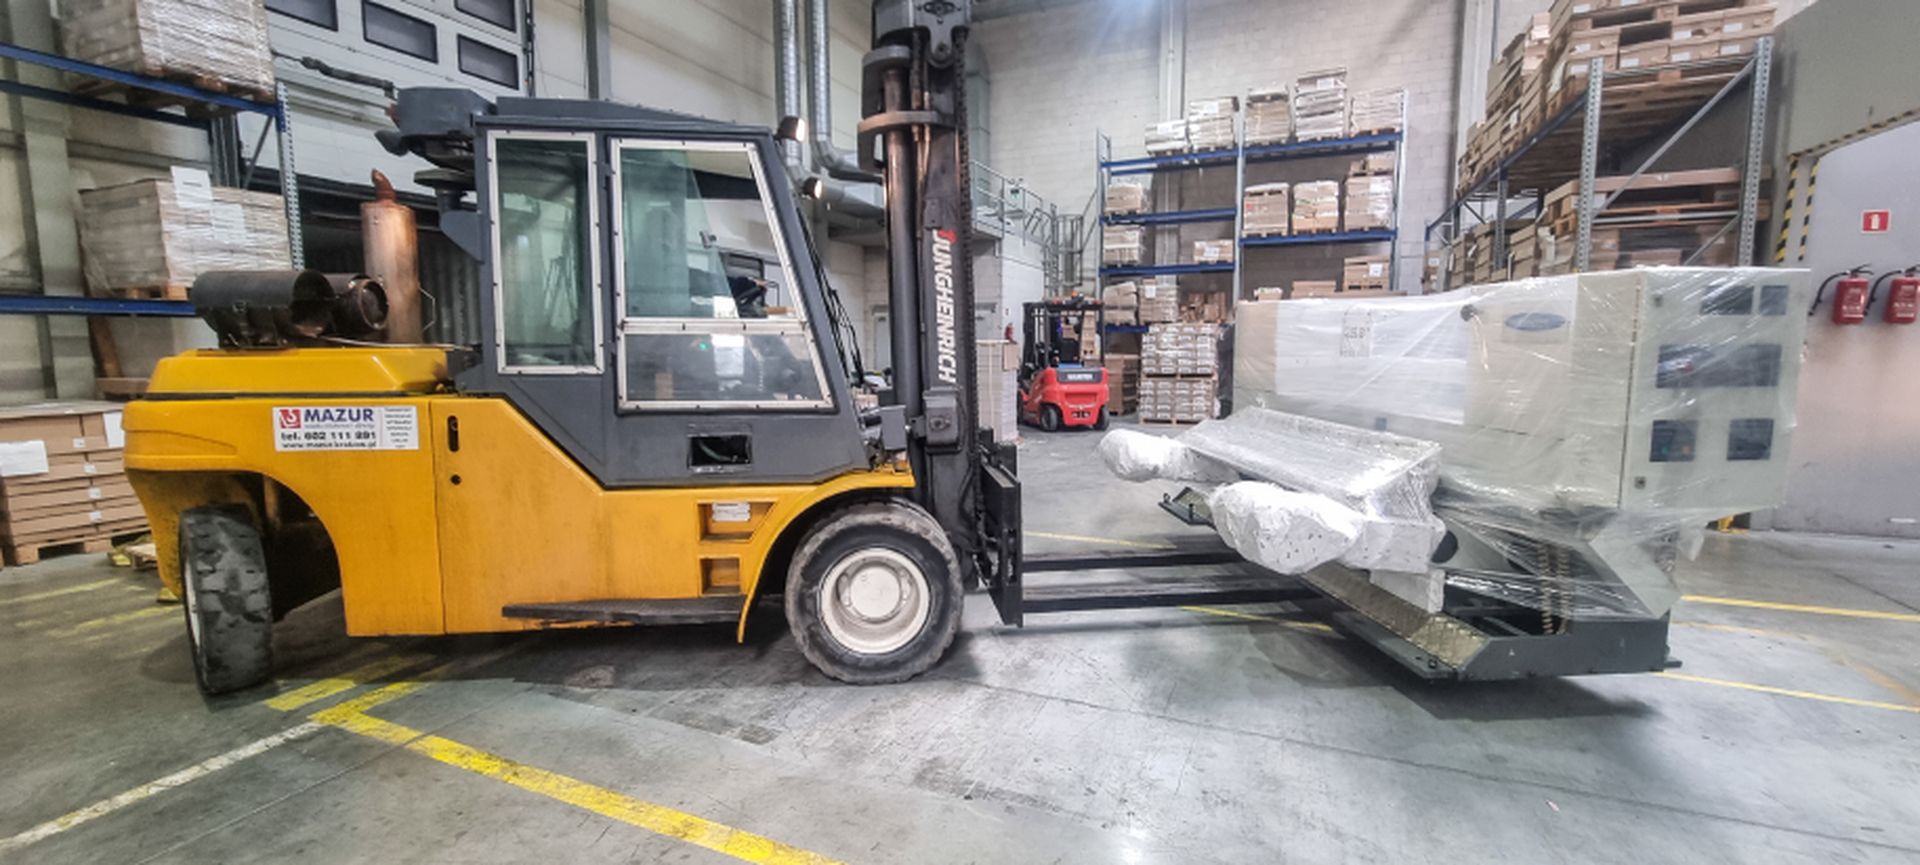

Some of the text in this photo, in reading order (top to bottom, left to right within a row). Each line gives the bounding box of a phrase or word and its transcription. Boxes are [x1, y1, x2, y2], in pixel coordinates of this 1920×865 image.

[932, 229, 957, 384] JUNGHEINRICH
[304, 408, 375, 422] MAZUR
[281, 431, 301, 441] tel.
